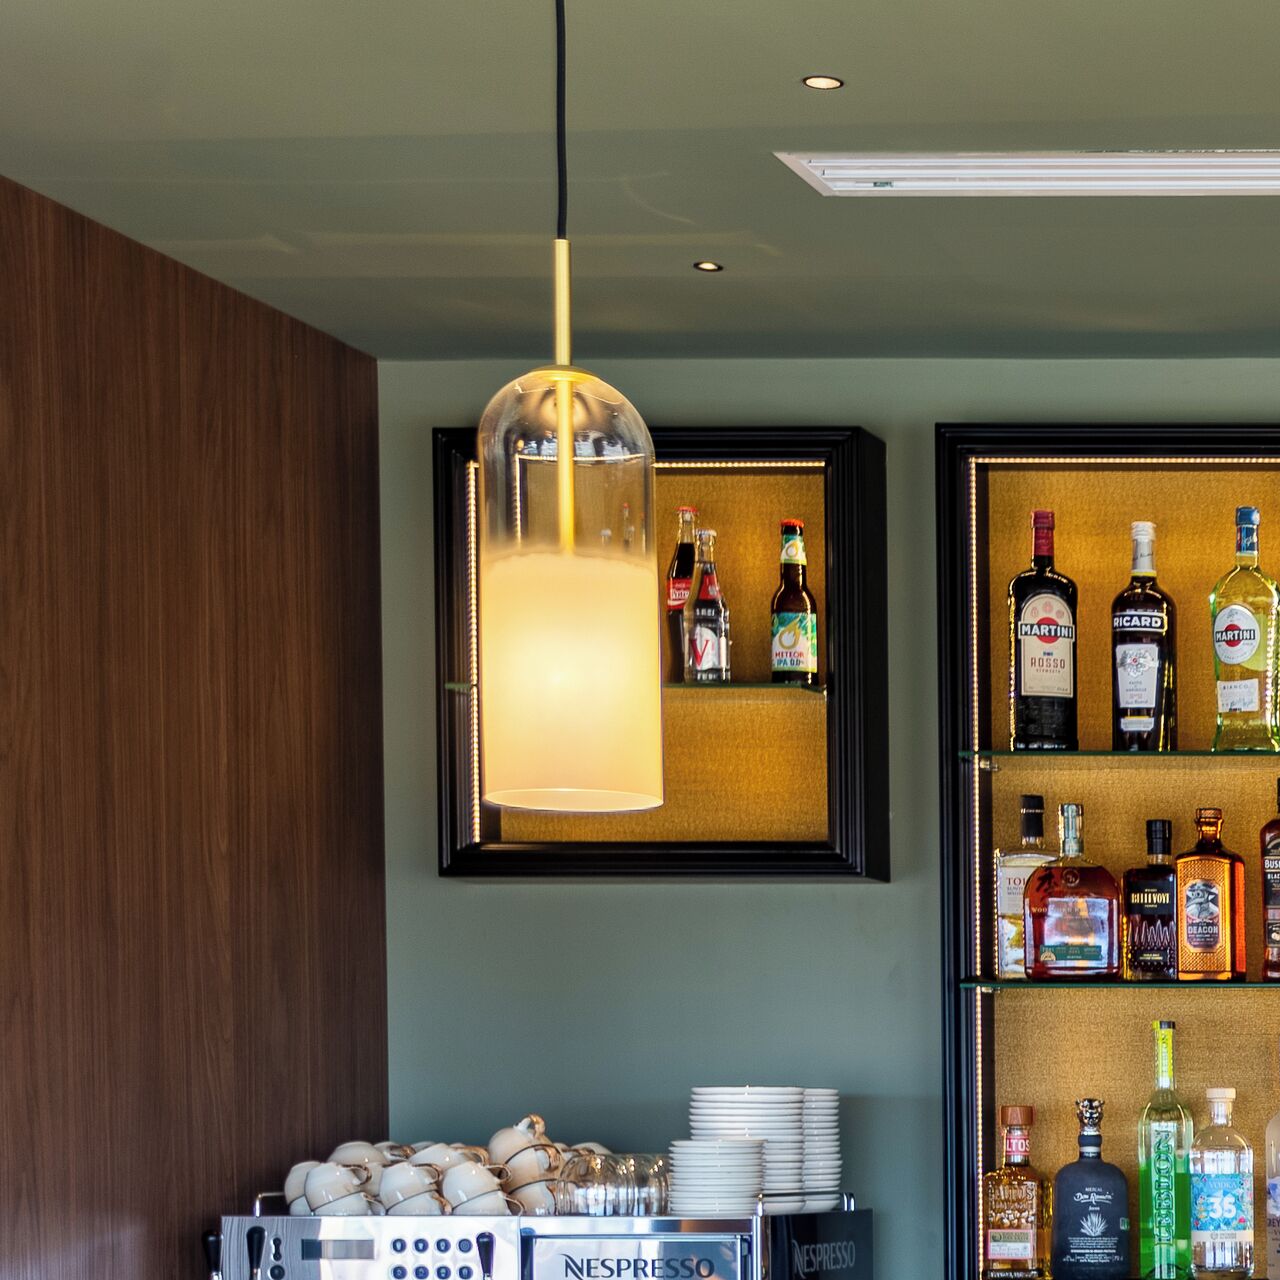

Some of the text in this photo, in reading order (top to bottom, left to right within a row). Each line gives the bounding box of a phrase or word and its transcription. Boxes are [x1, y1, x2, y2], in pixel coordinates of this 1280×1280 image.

[1113, 616, 1162, 628] RICARD
[1021, 625, 1072, 638] MARTINI
[1216, 629, 1255, 642] MARTINI
[1030, 657, 1066, 669] ROSSO
[1007, 877, 1026, 886] TO
[1188, 926, 1218, 935] DEACON
[1005, 1139, 1030, 1151] LTOS
[1154, 1129, 1176, 1246] LEBLON
[792, 1239, 856, 1280] NESPRESSO
